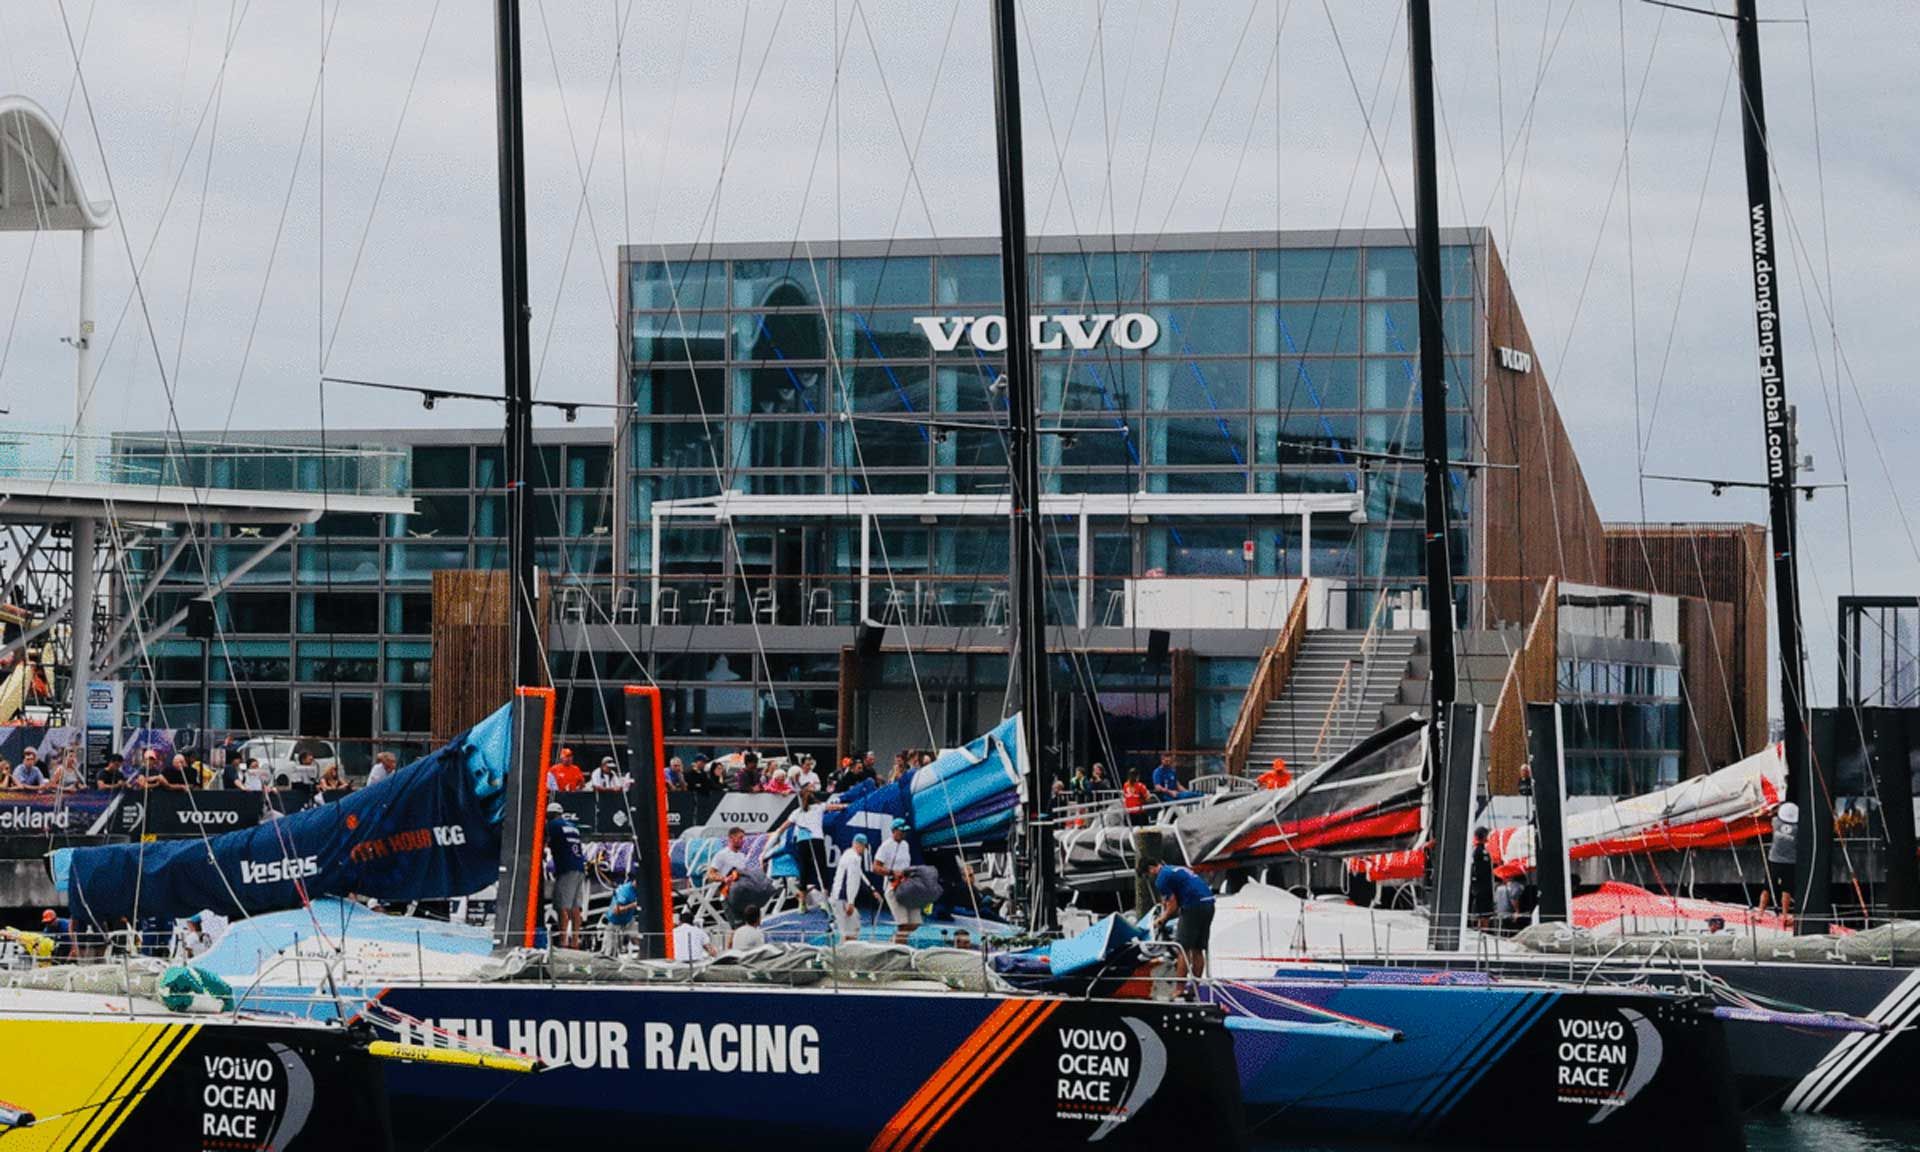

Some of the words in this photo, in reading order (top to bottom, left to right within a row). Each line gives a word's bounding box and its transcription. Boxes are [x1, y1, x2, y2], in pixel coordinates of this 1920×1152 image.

[913, 313, 1159, 351] VOLVO
[1752, 204, 1784, 478] www.dongfeng-global.com
[176, 810, 239, 824] VOLVO
[720, 811, 769, 823] VOLVO
[240, 855, 318, 884] Vestas
[1059, 1028, 1127, 1052] VOLVO
[1559, 1018, 1624, 1041] VOLVO
[509, 1019, 630, 1070] HOUR
[644, 1022, 820, 1075] RACING
[1558, 1042, 1626, 1065] OCEAN
[204, 1055, 273, 1082] VOLVO
[1058, 1053, 1129, 1077] OCEAN
[1558, 1065, 1609, 1087] RACE
[203, 1084, 276, 1111] OCEAN
[1057, 1078, 1110, 1102] RACE
[203, 1113, 256, 1139] RACE
